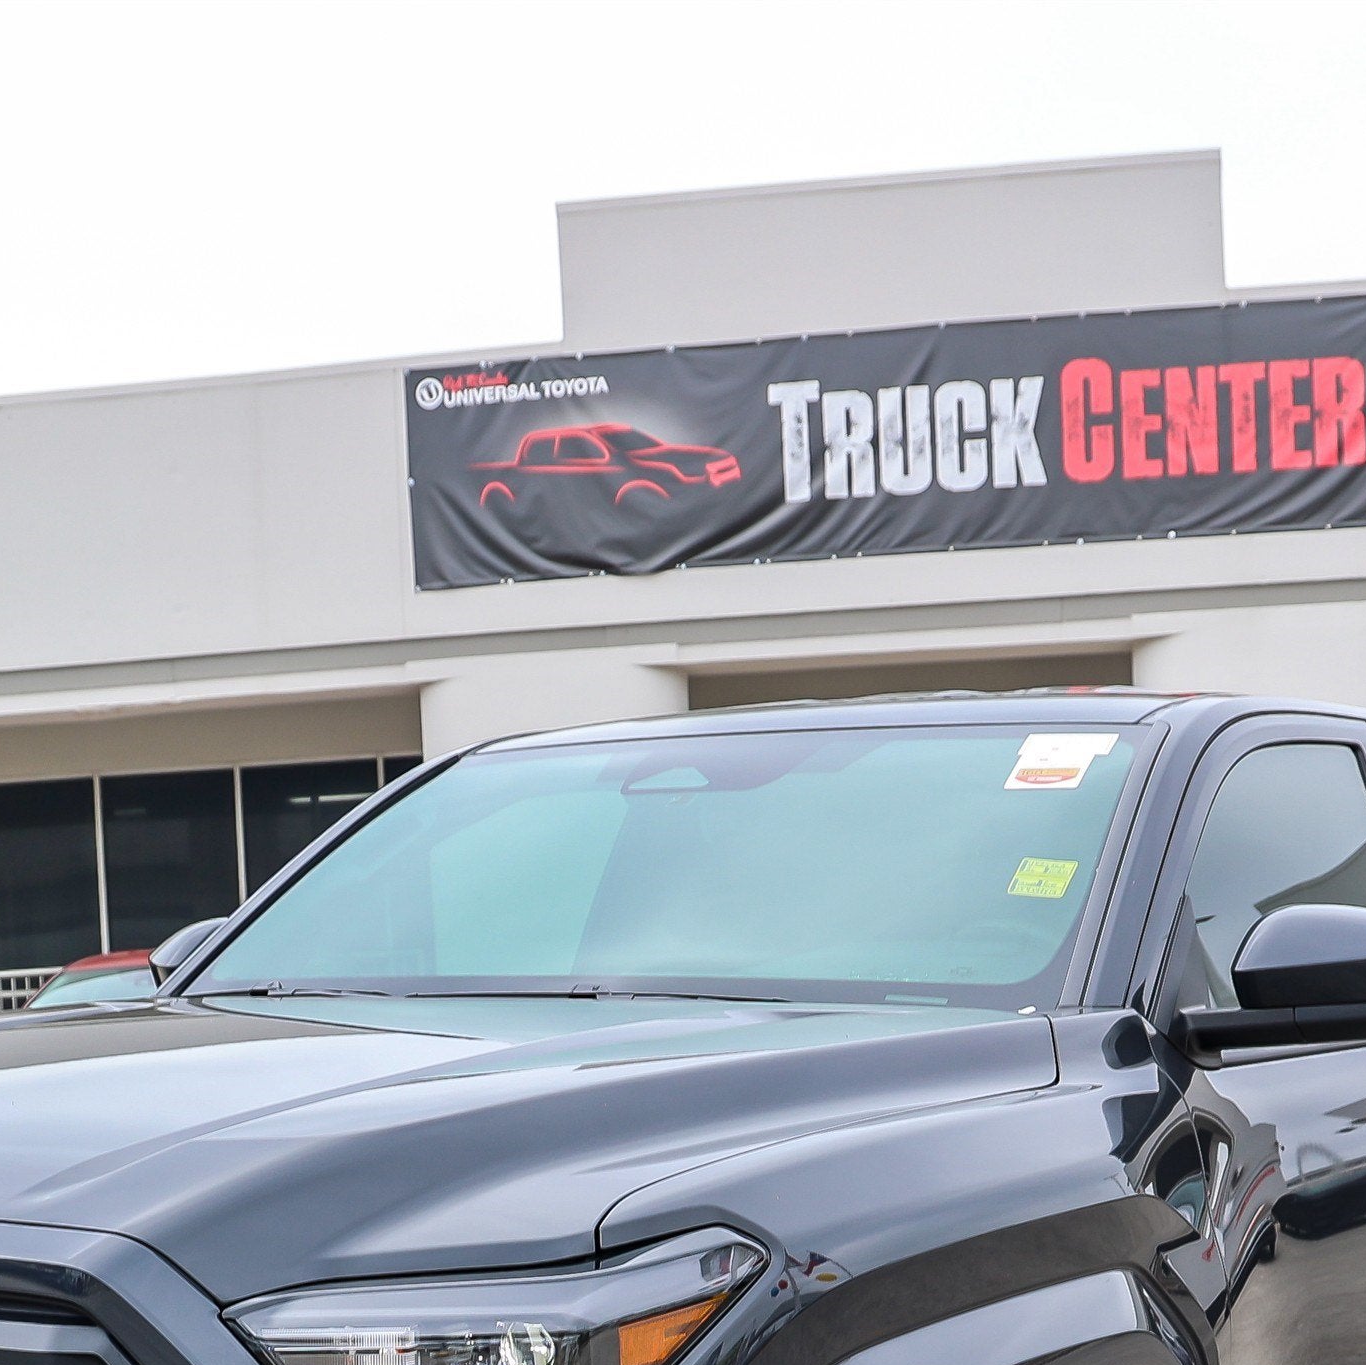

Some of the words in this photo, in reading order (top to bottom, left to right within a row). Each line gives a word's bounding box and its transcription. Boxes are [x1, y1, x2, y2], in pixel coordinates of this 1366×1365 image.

[443, 382, 541, 409] UNIVERSAL
[540, 375, 610, 399] TOYOTA
[765, 375, 1049, 503] TRUCK
